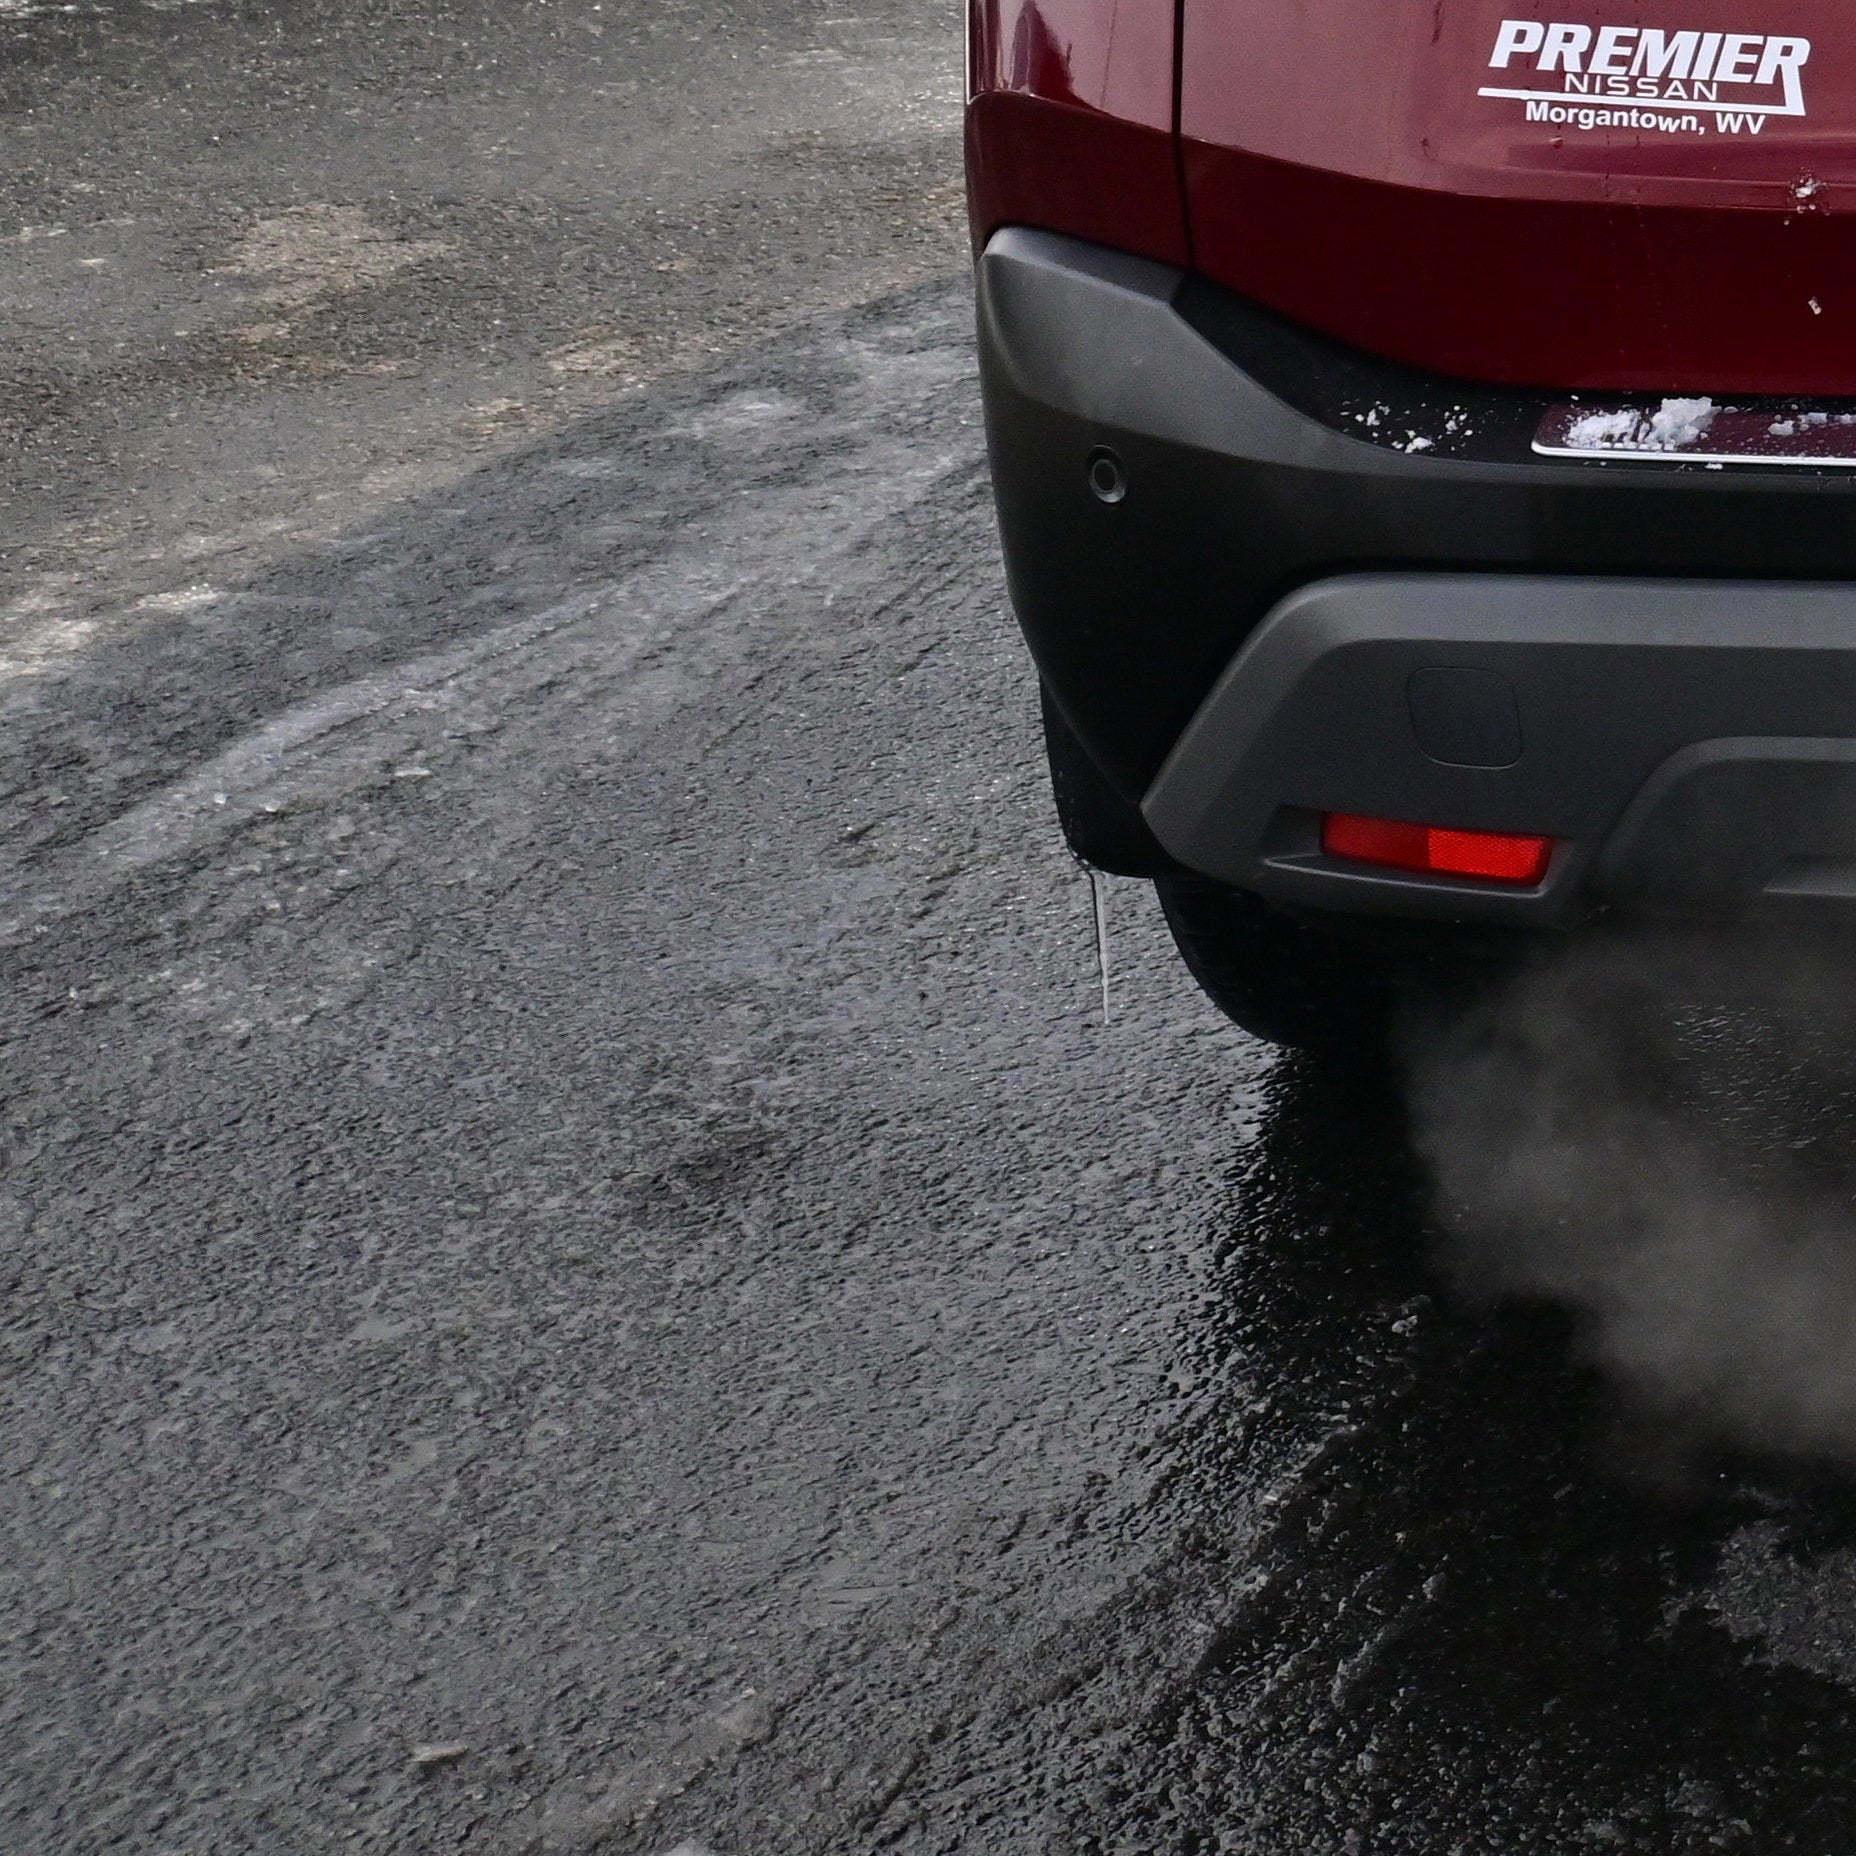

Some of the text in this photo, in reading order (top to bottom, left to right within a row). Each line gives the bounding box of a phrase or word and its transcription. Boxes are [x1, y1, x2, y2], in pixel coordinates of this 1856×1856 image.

[1488, 19, 1812, 115] PREMIER
[1564, 73, 1718, 102] NISSAN
[1525, 100, 1767, 136] Morgantown, WV
